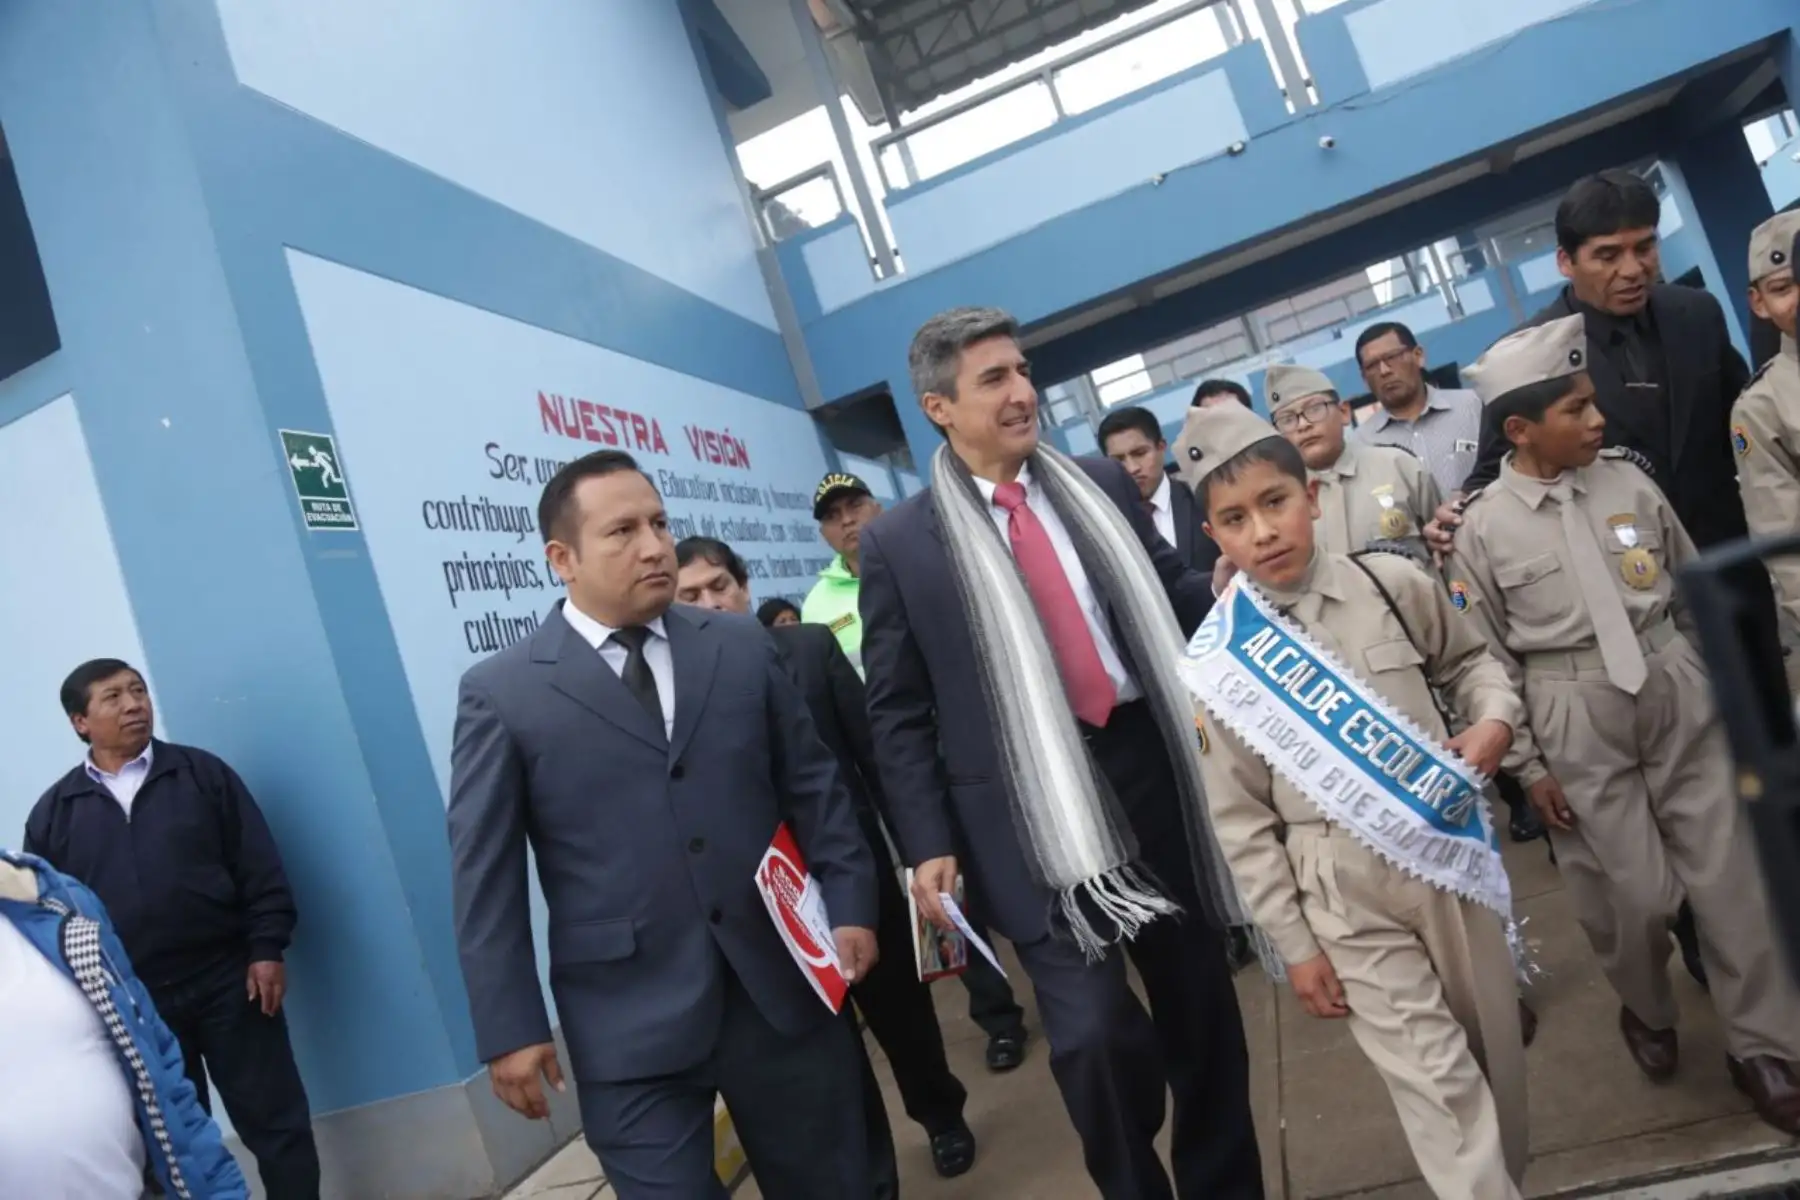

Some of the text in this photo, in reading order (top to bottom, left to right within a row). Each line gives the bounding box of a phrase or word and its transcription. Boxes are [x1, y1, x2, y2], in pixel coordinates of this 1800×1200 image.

[538, 390, 751, 471] NUESTRA VISIÓN
[485, 442, 532, 485] Ser,
[658, 469, 720, 502] Educativa
[422, 494, 535, 543] contribuya
[442, 552, 544, 609] principios,
[1240, 627, 1351, 725] ALCALDE
[1339, 708, 1456, 810] ESCOLAR
